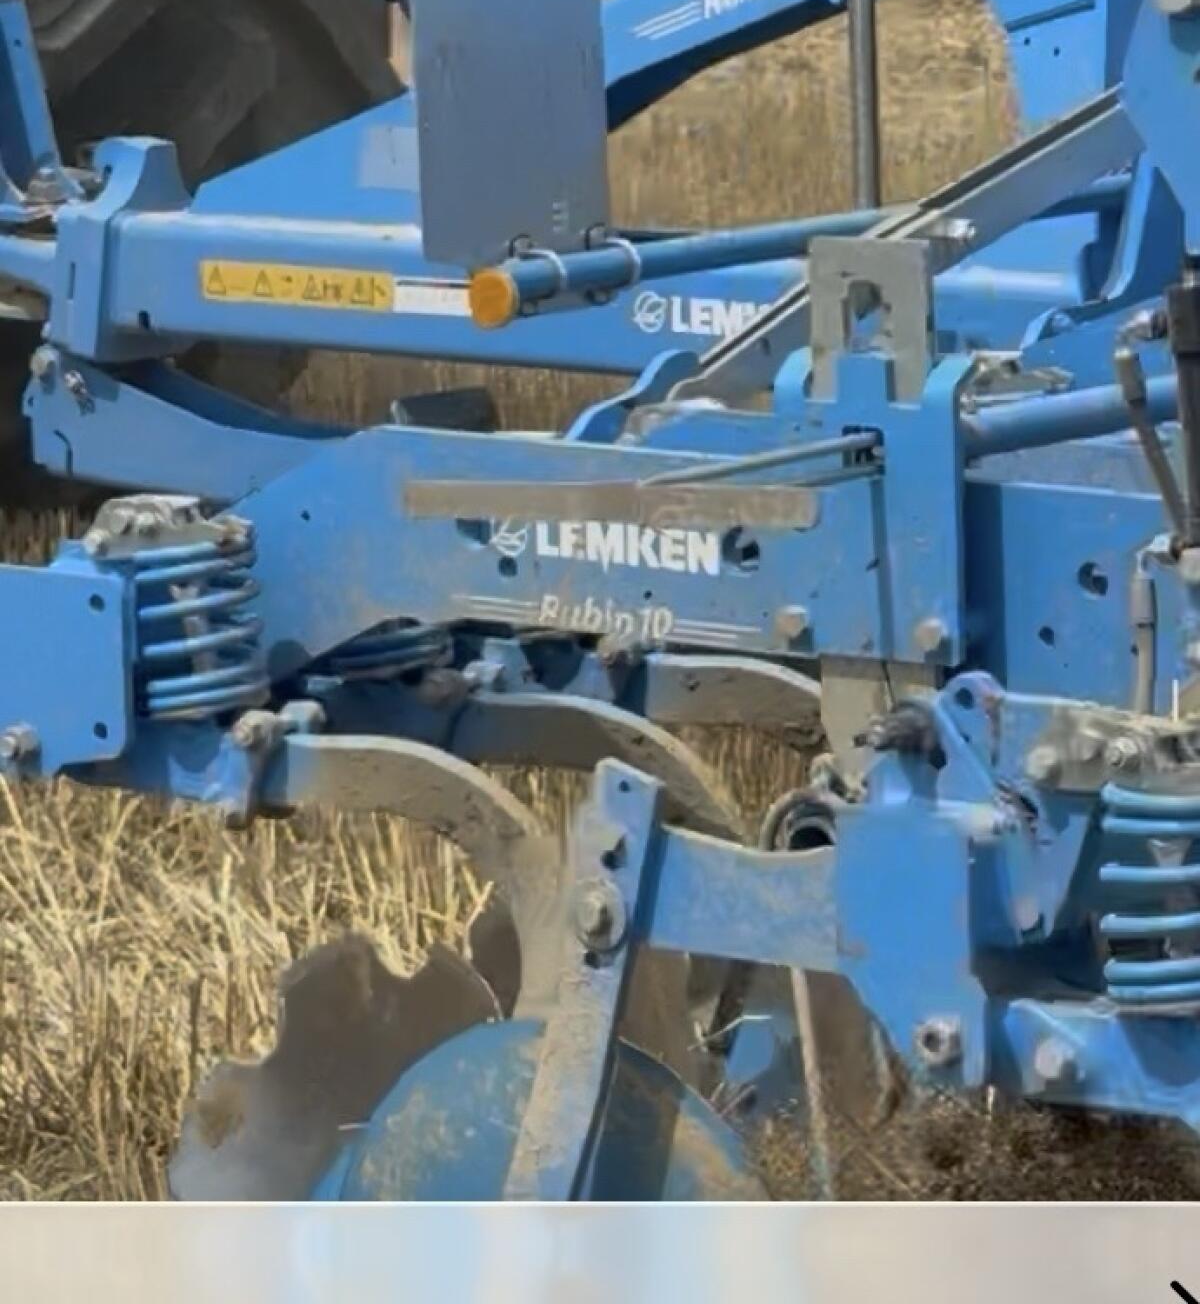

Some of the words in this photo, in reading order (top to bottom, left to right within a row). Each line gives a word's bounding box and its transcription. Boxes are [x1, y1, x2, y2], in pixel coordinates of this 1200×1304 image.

[536, 519, 720, 576] LEMKEN
[538, 594, 635, 635] Rubin
[639, 603, 674, 642] 10
